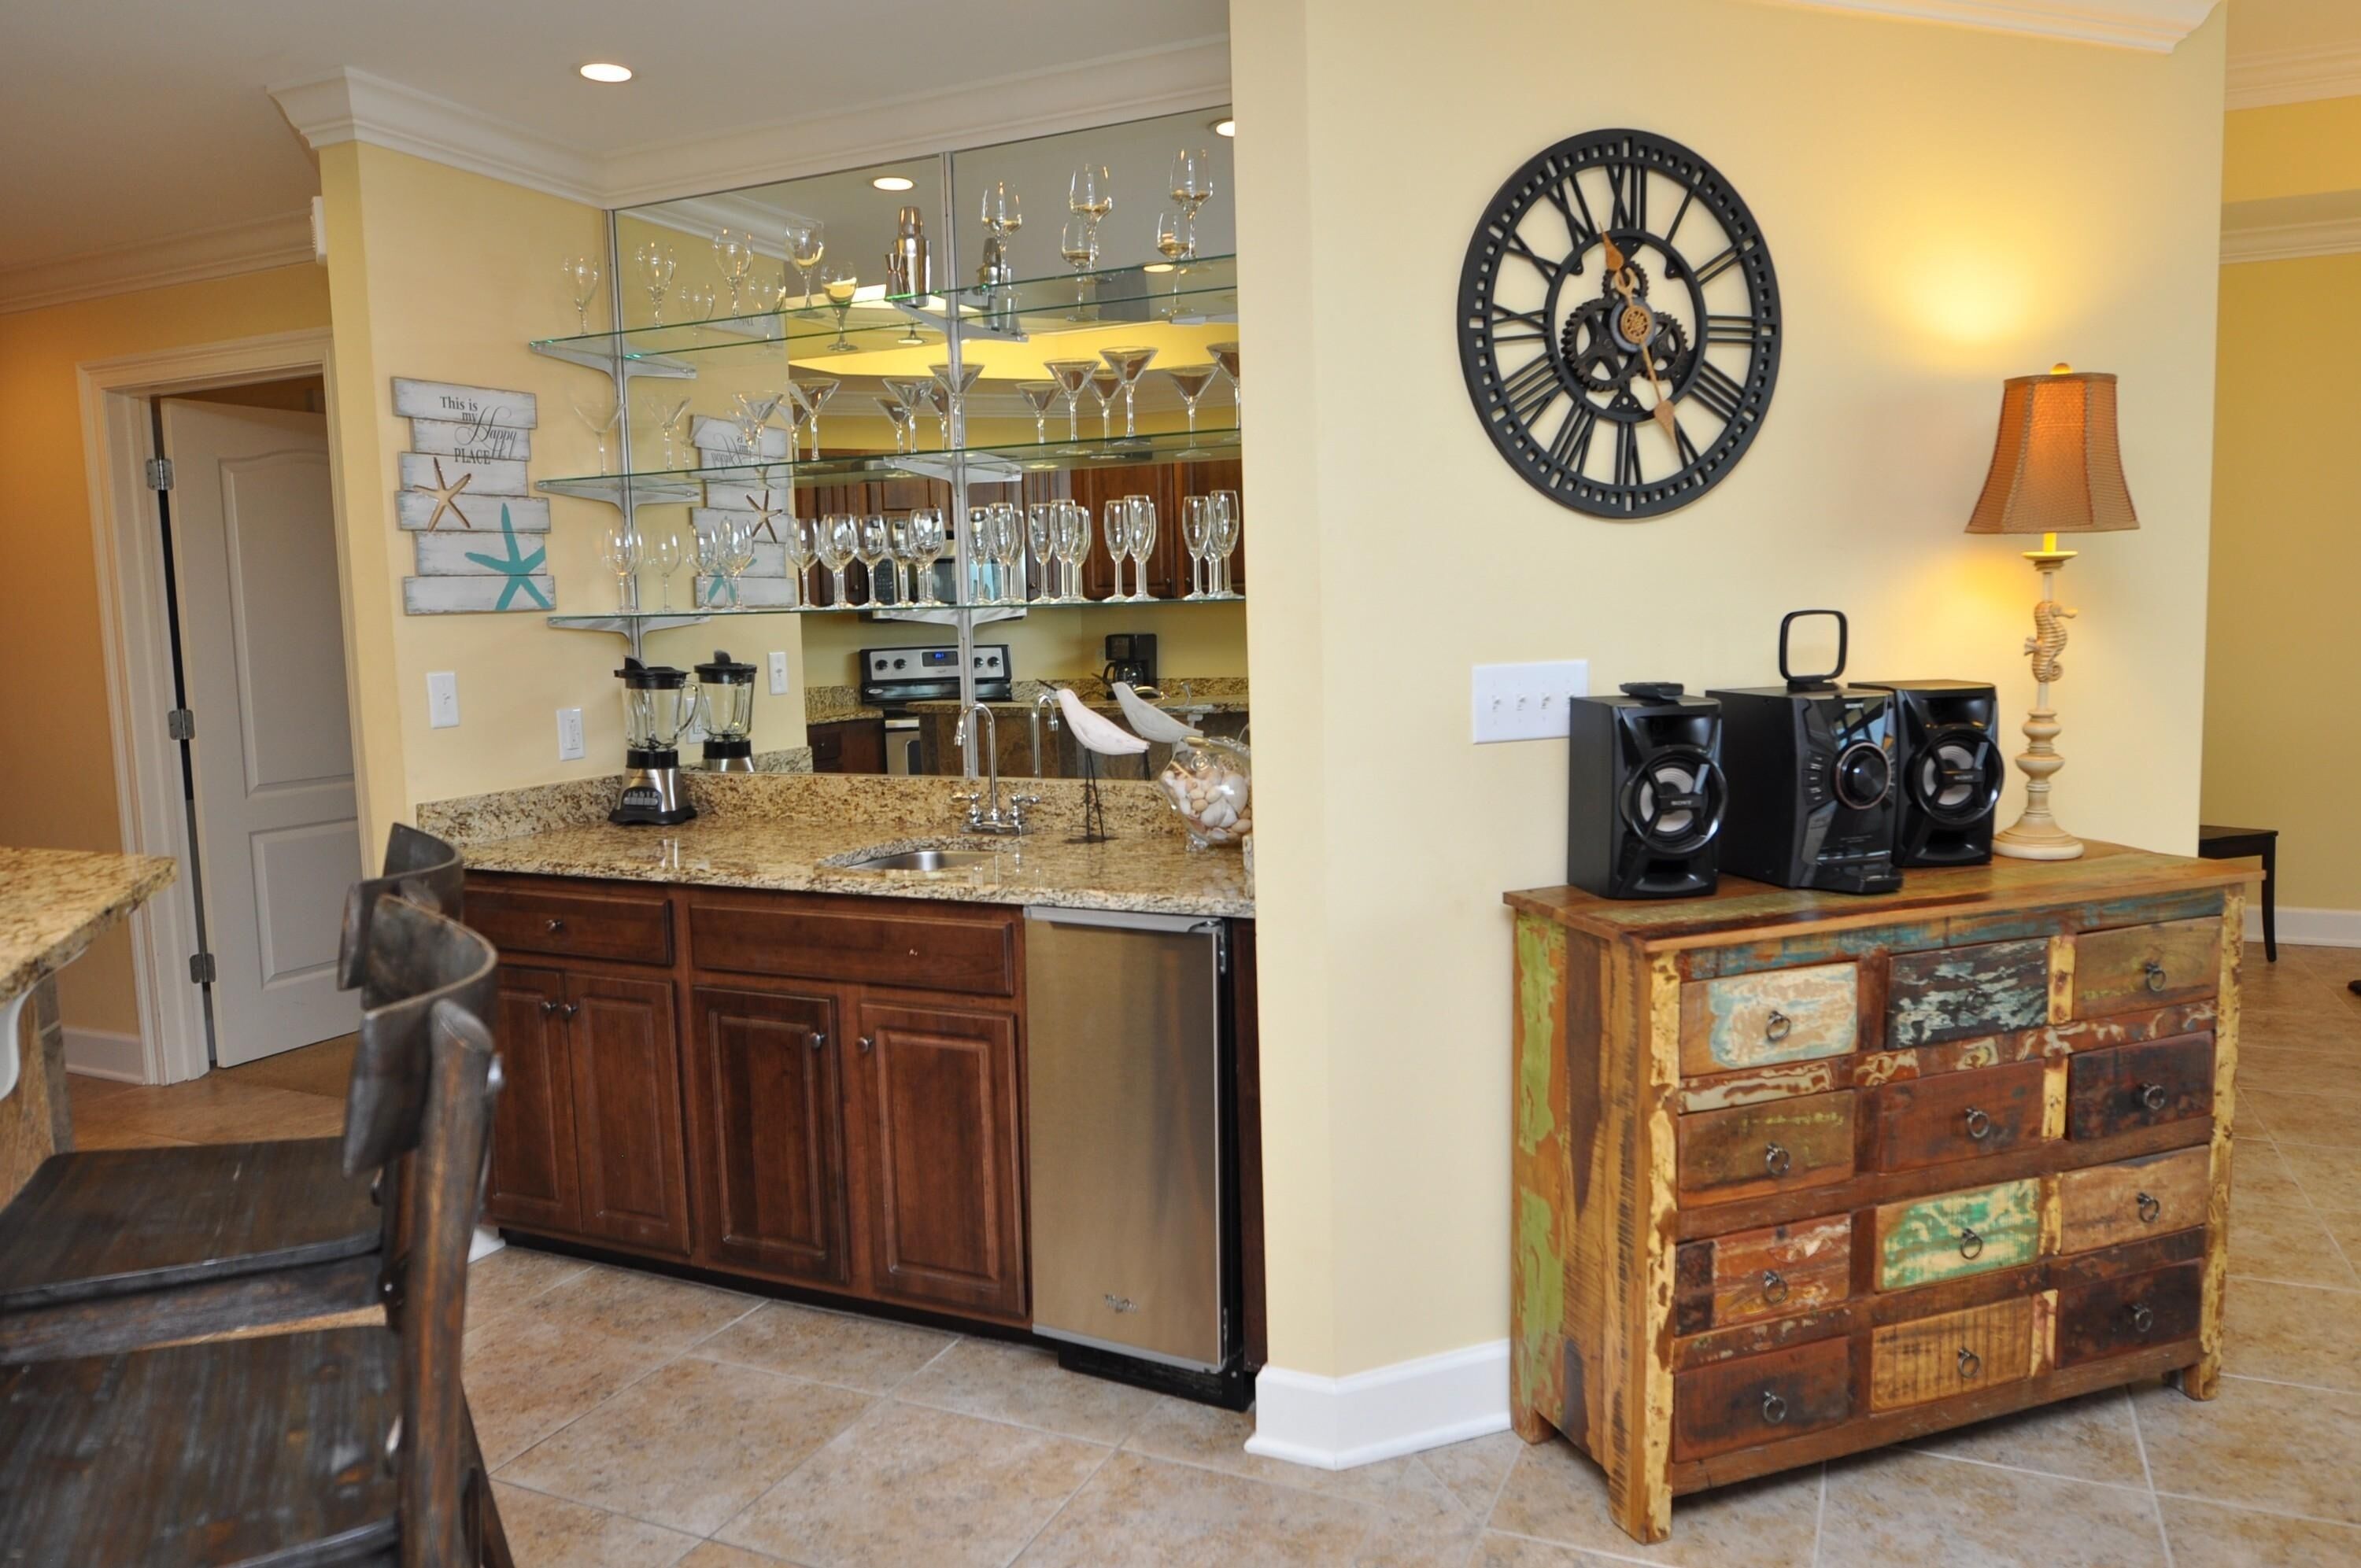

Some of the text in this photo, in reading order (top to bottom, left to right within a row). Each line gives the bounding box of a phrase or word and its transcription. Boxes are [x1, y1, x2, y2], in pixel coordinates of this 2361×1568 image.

[1545, 175, 1598, 247] XI
[1605, 163, 1647, 233] XII
[1665, 186, 1697, 245] I
[1507, 233, 1564, 284] X
[1693, 242, 1742, 286] II
[1706, 315, 1756, 343] III
[440, 396, 478, 411] This is
[1502, 352, 1566, 430] VIII
[455, 405, 517, 459] Happy
[462, 411, 477, 423] my
[454, 447, 490, 465] PLACE
